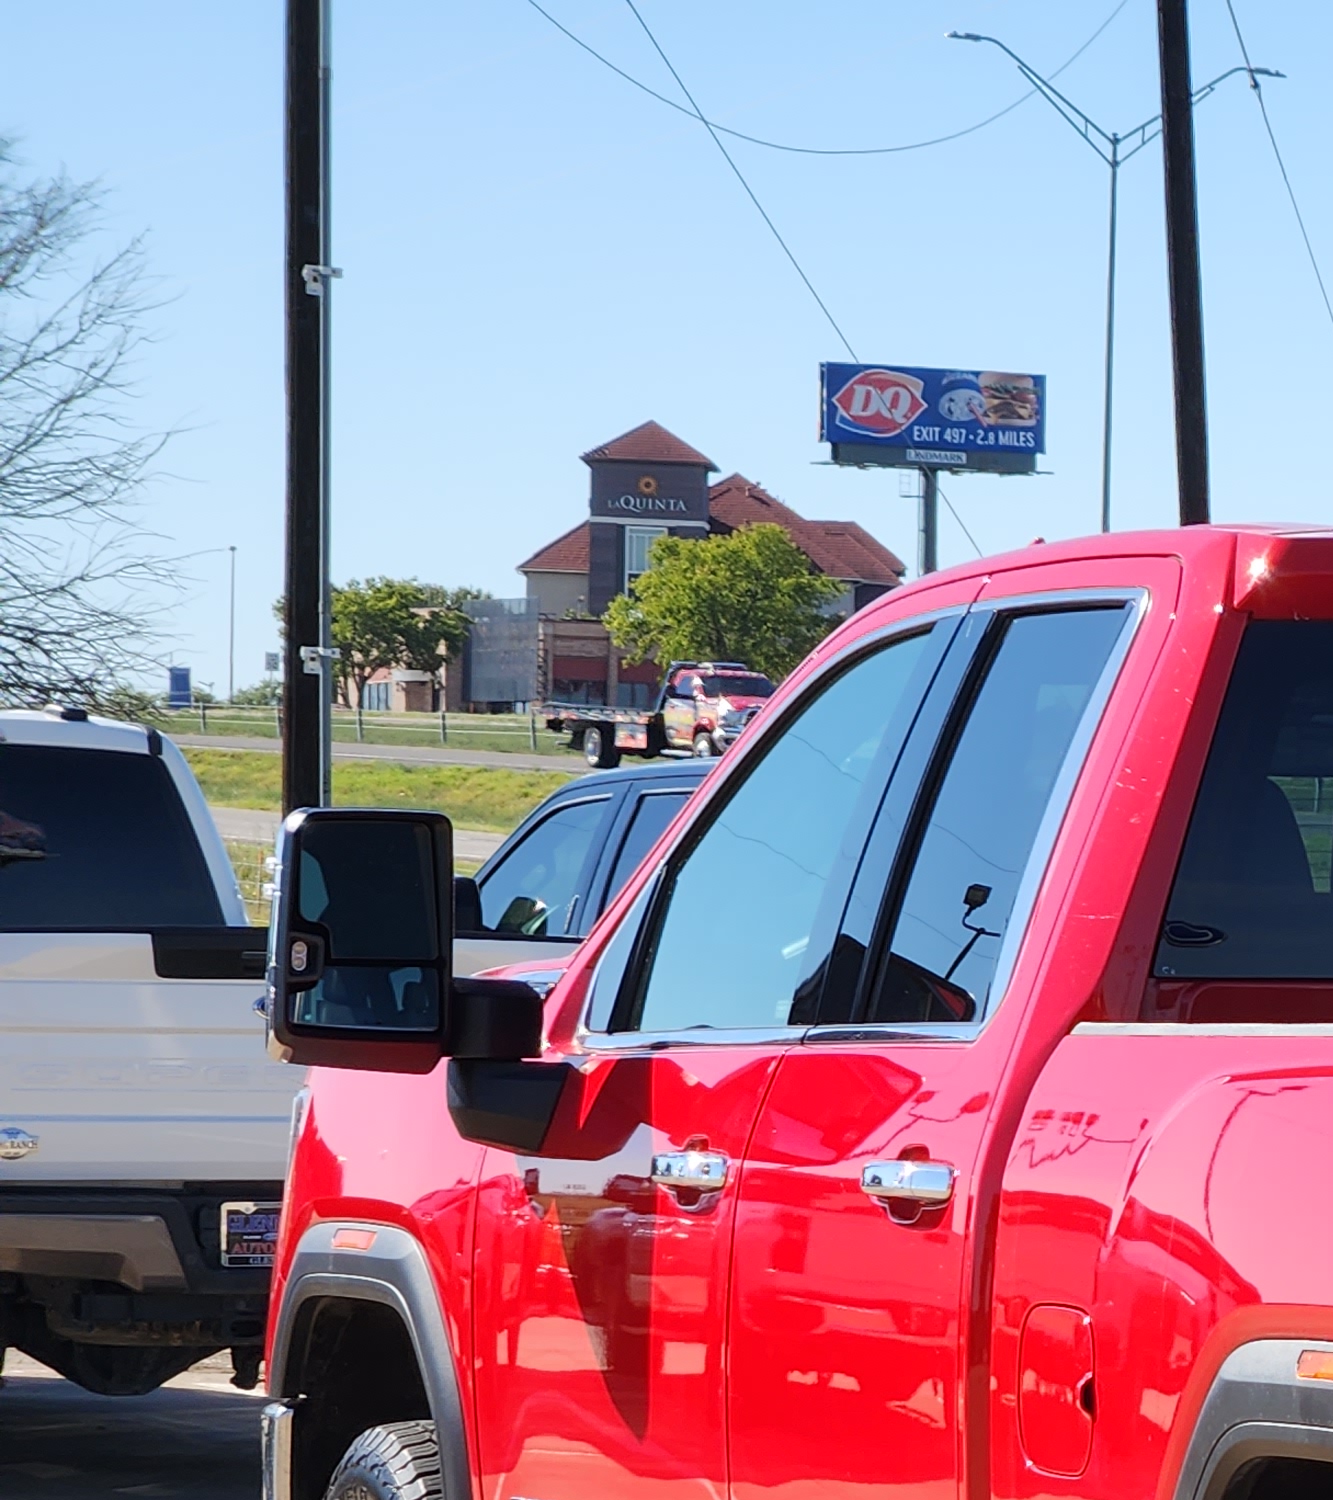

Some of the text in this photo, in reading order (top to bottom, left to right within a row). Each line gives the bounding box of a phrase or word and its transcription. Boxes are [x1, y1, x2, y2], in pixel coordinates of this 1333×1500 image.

[851, 384, 912, 423] DQ
[913, 426, 939, 442] EXIT
[944, 428, 966, 443] 497
[999, 432, 1035, 447] MILES
